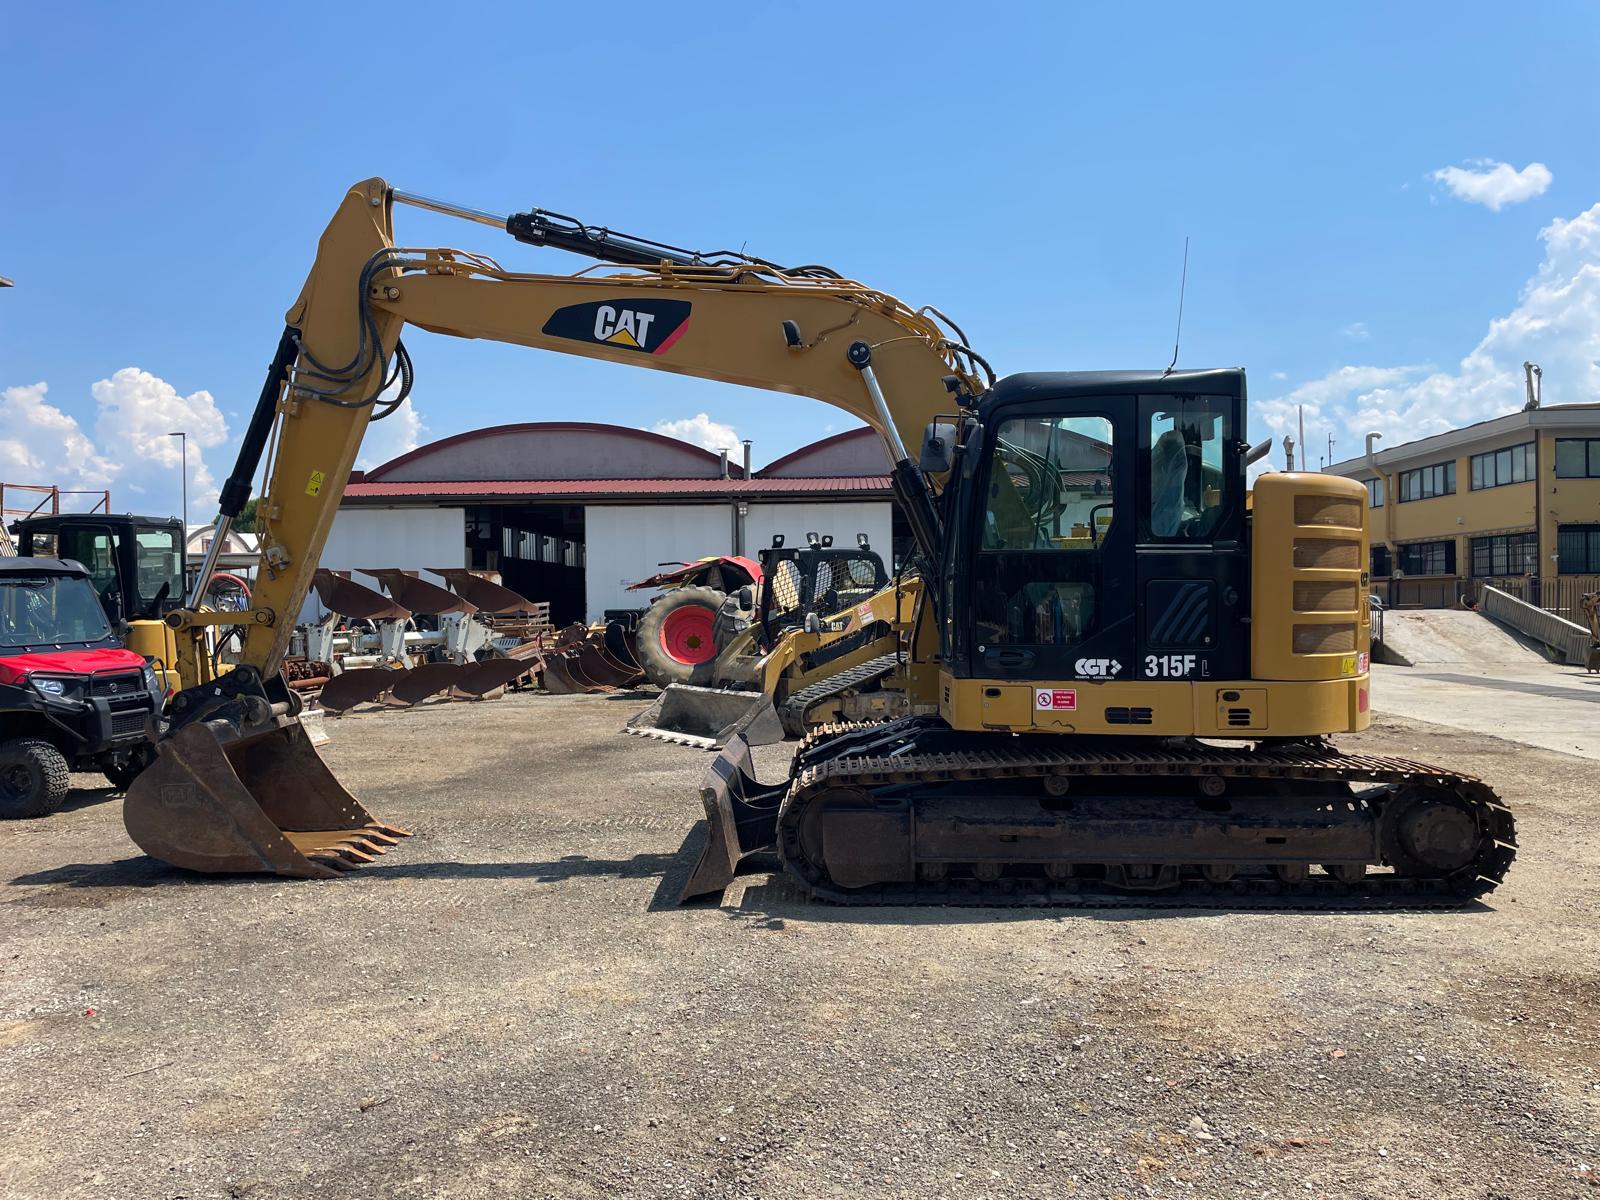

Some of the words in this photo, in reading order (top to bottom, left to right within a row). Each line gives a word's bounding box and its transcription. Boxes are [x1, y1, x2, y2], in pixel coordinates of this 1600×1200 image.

[594, 305, 655, 348] CAT
[831, 621, 843, 631] CAT
[1074, 658, 1110, 675] CGT
[1145, 655, 1196, 677] 315F
